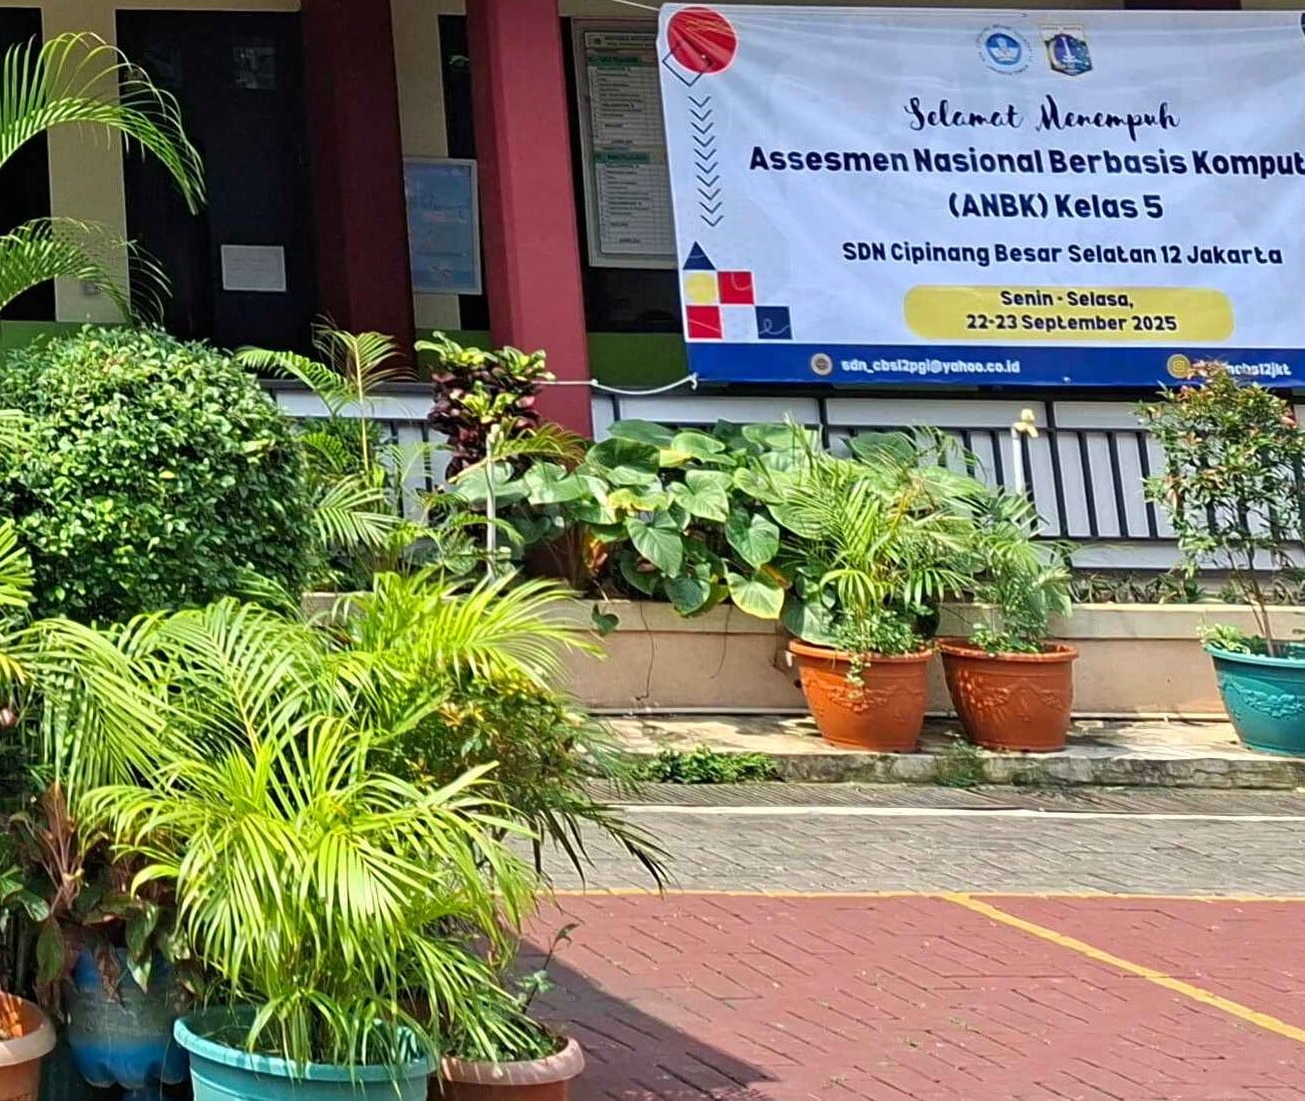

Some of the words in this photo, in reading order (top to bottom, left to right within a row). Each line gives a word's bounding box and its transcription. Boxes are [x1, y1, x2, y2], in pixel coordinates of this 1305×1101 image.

[903, 97, 1023, 130] Selamat
[1035, 94, 1180, 142] Menempuh
[749, 146, 909, 171] Assesmen
[912, 147, 1044, 173] Nasional
[1048, 149, 1188, 174] Berbasis
[1192, 150, 1305, 179] Komput
[949, 192, 1048, 219] (ANBK)
[1054, 194, 1138, 219] Kelas
[1143, 195, 1163, 219] 5
[842, 242, 886, 261] SDN
[891, 241, 991, 267] Cipinang
[994, 243, 1062, 263] Besar
[1068, 244, 1157, 264] Selatan
[1160, 246, 1182, 264] 12
[1187, 246, 1283, 265] Jakarta
[1000, 290, 1053, 306] Senin
[1066, 291, 1133, 309] Selasa,
[966, 315, 1018, 330] 22-23
[1022, 315, 1127, 332] September
[1131, 316, 1178, 331] 2025
